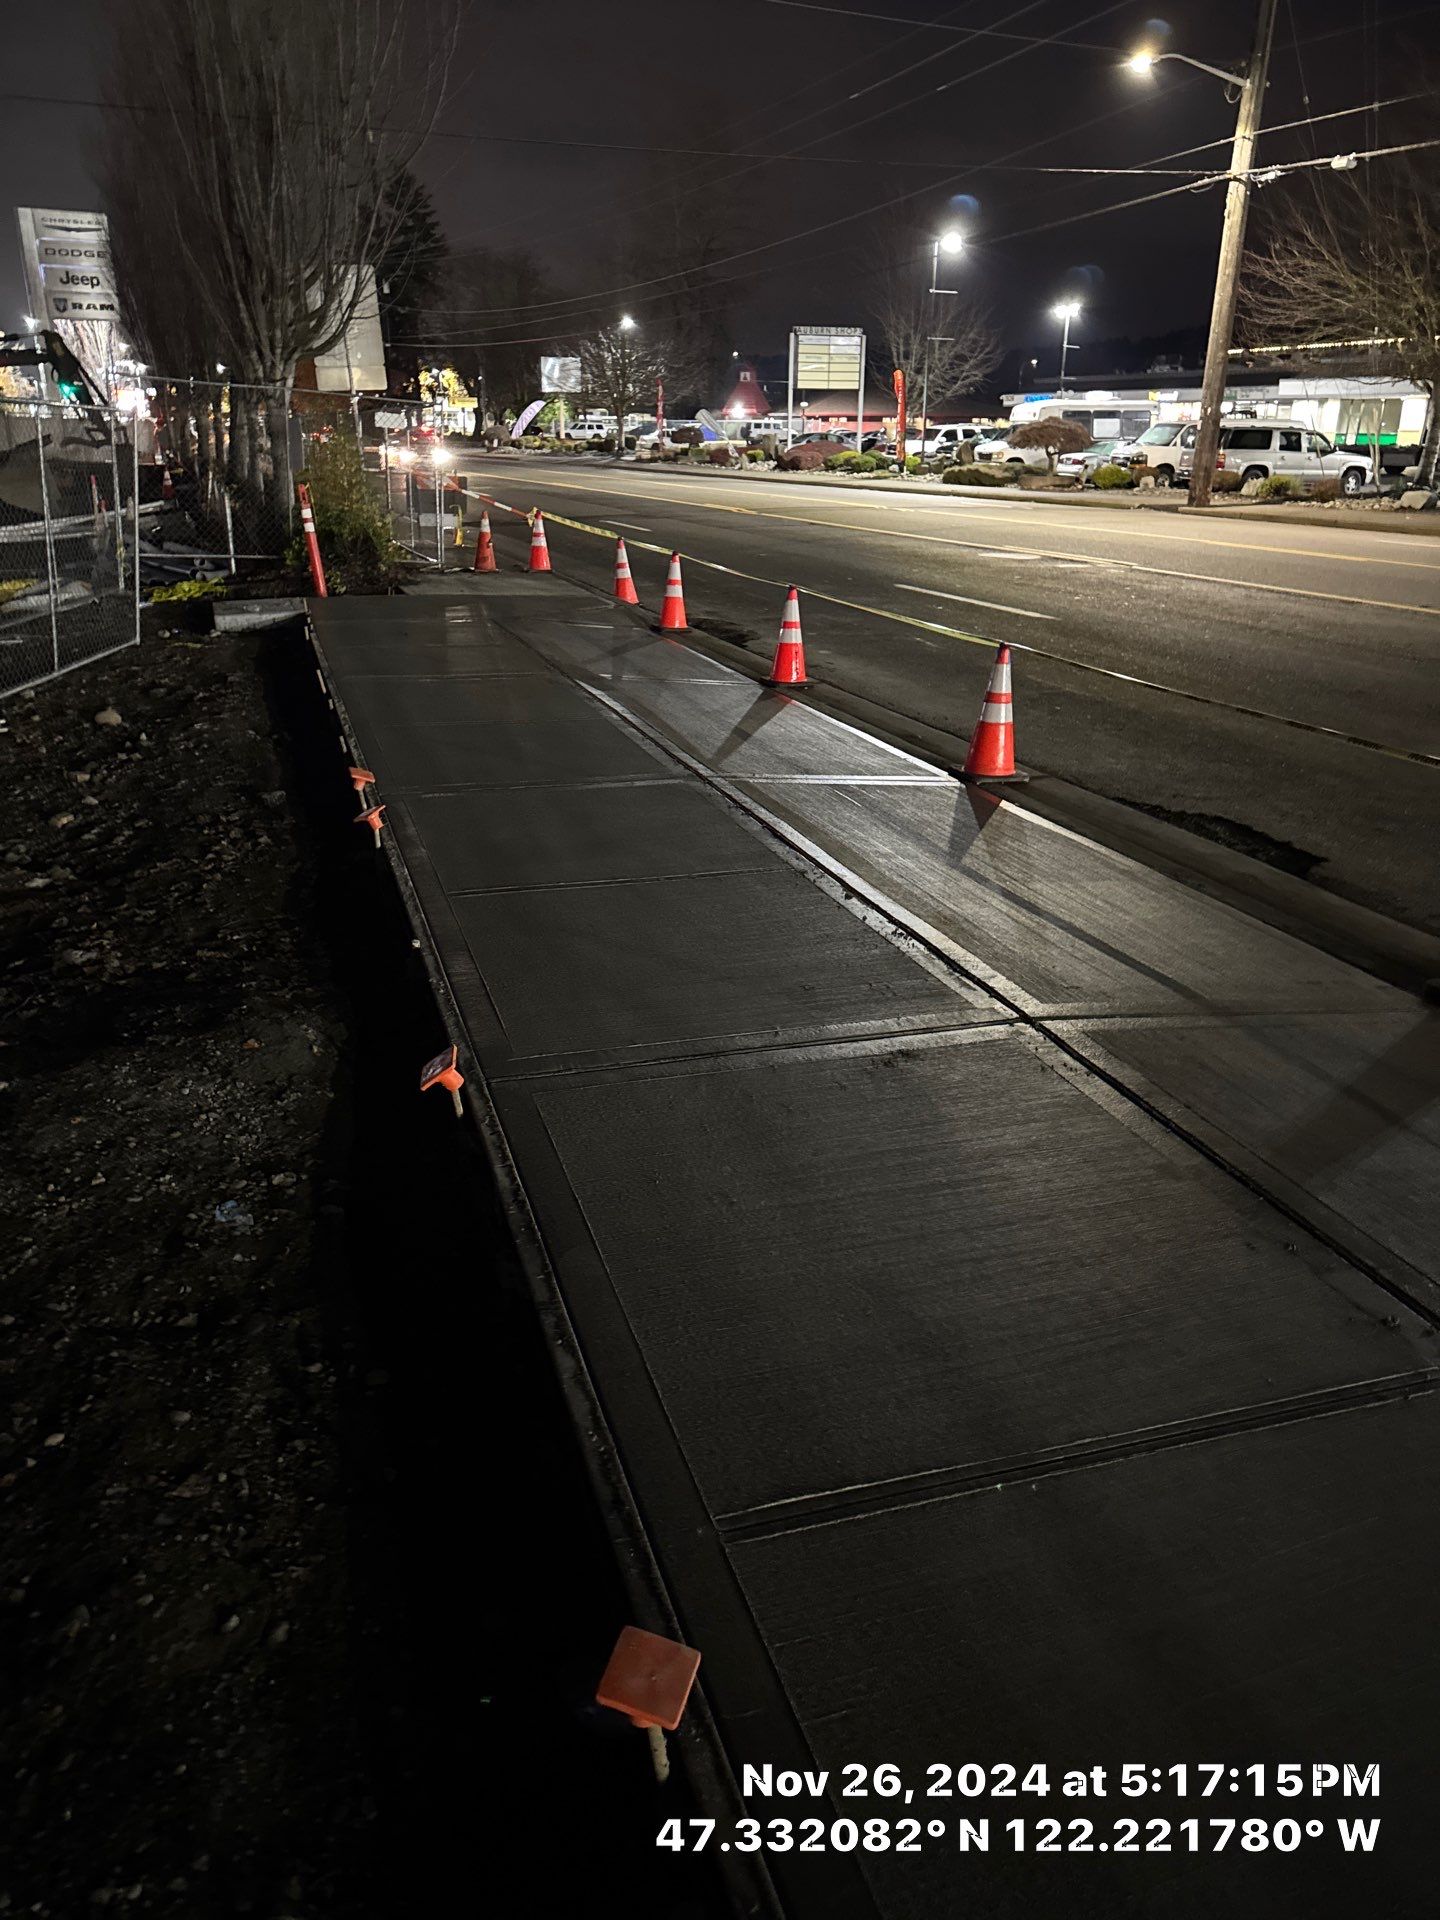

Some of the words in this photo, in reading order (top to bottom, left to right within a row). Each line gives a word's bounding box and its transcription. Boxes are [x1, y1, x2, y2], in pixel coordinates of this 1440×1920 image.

[44, 247, 108, 258] DODGE
[59, 270, 101, 289] Jeep
[71, 302, 115, 311] RAM
[797, 327, 831, 335] AUBURN
[835, 327, 864, 336] SHOPS
